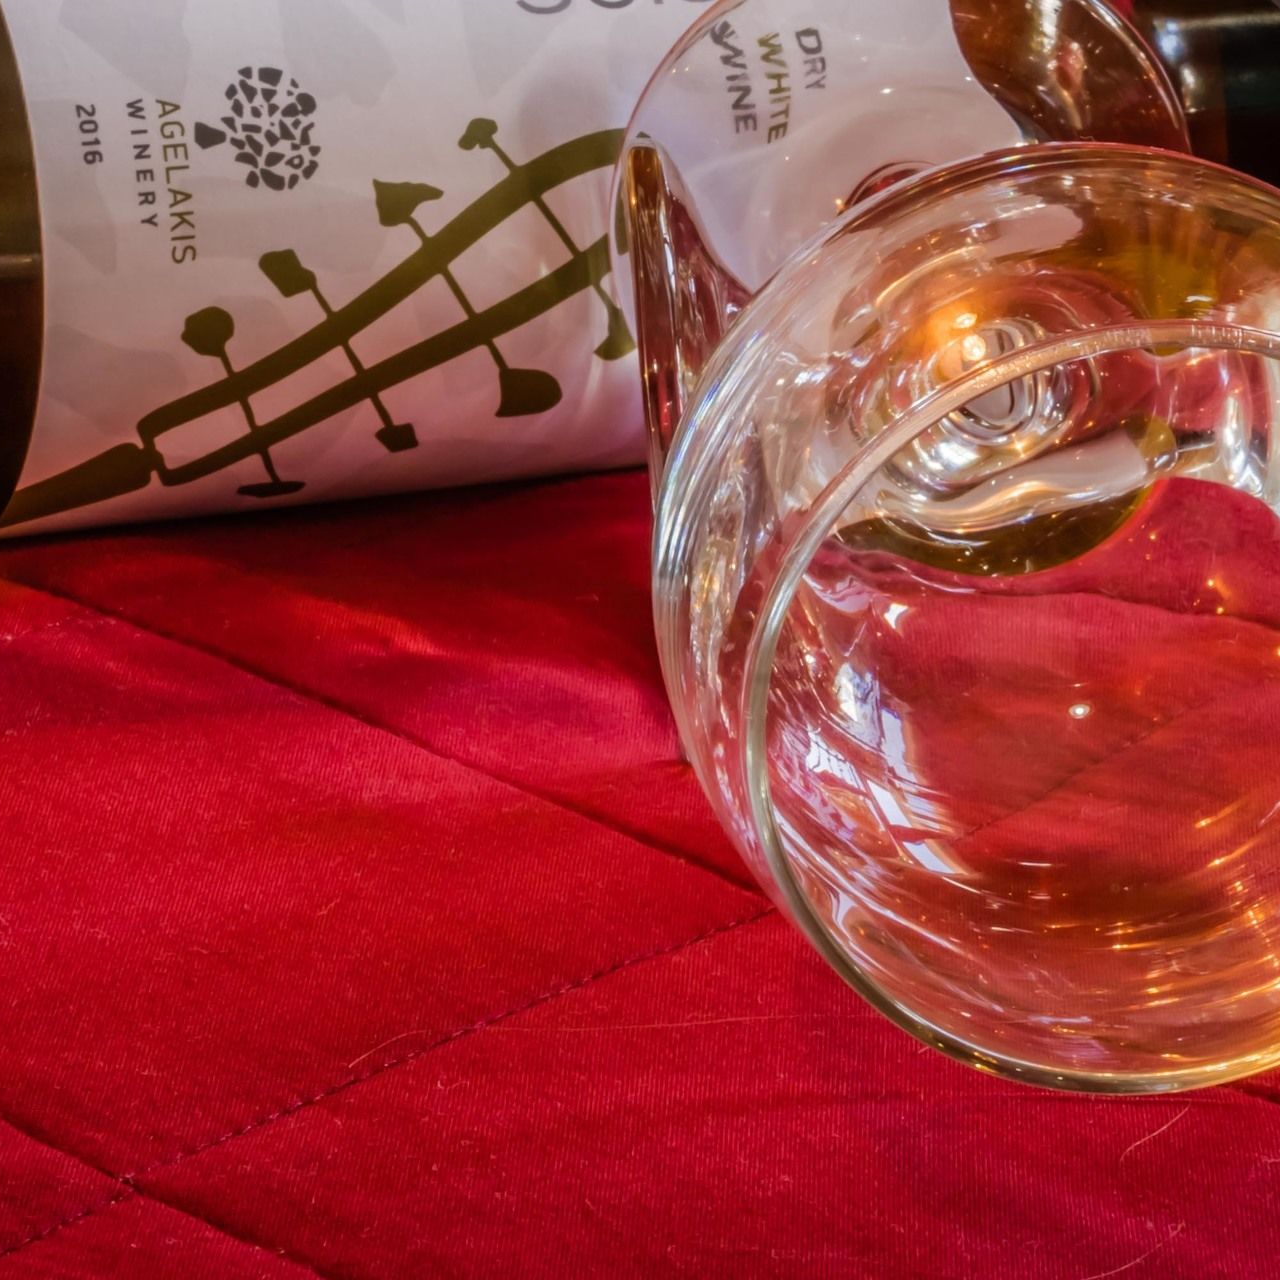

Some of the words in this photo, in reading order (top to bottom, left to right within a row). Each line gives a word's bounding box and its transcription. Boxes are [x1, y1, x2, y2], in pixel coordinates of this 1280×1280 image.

[710, 20, 758, 134] WINE
[757, 31, 792, 144] WHITE
[795, 27, 827, 90] DRY
[75, 103, 104, 166] 2016
[126, 98, 159, 228] WINERY
[156, 98, 197, 265] AGELAKIS
